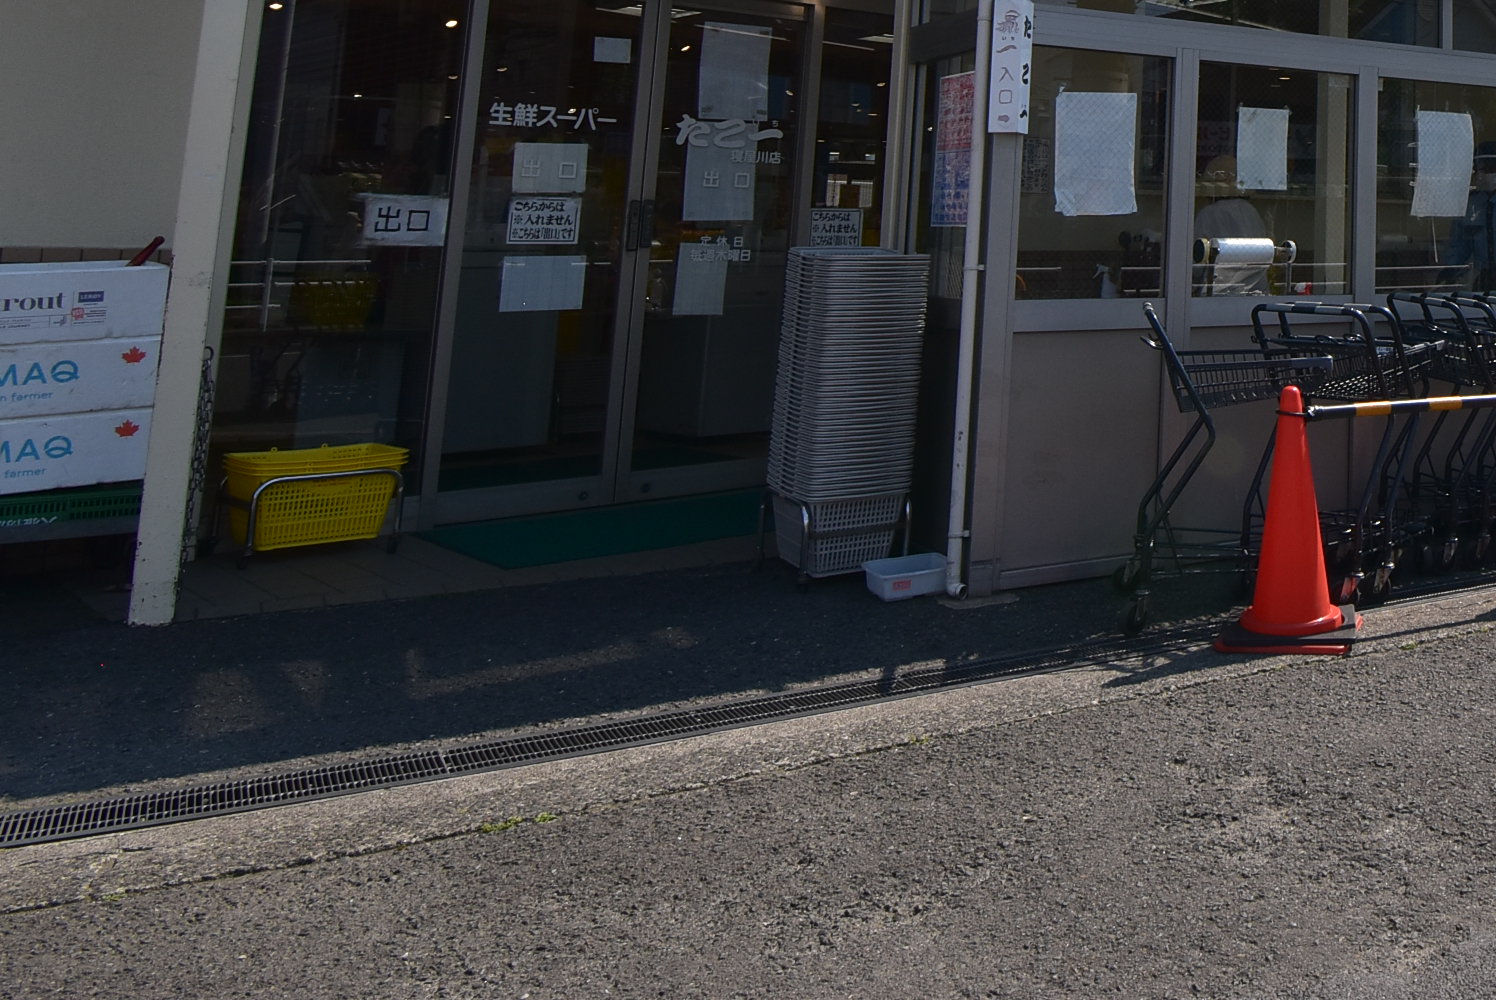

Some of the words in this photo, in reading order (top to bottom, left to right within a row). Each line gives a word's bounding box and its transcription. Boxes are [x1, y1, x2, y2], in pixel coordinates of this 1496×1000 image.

[998, 66, 1014, 105] 入口
[489, 102, 617, 131] 生鮮スーパー
[372, 205, 431, 233] 出口
[514, 201, 565, 213] こちらからは
